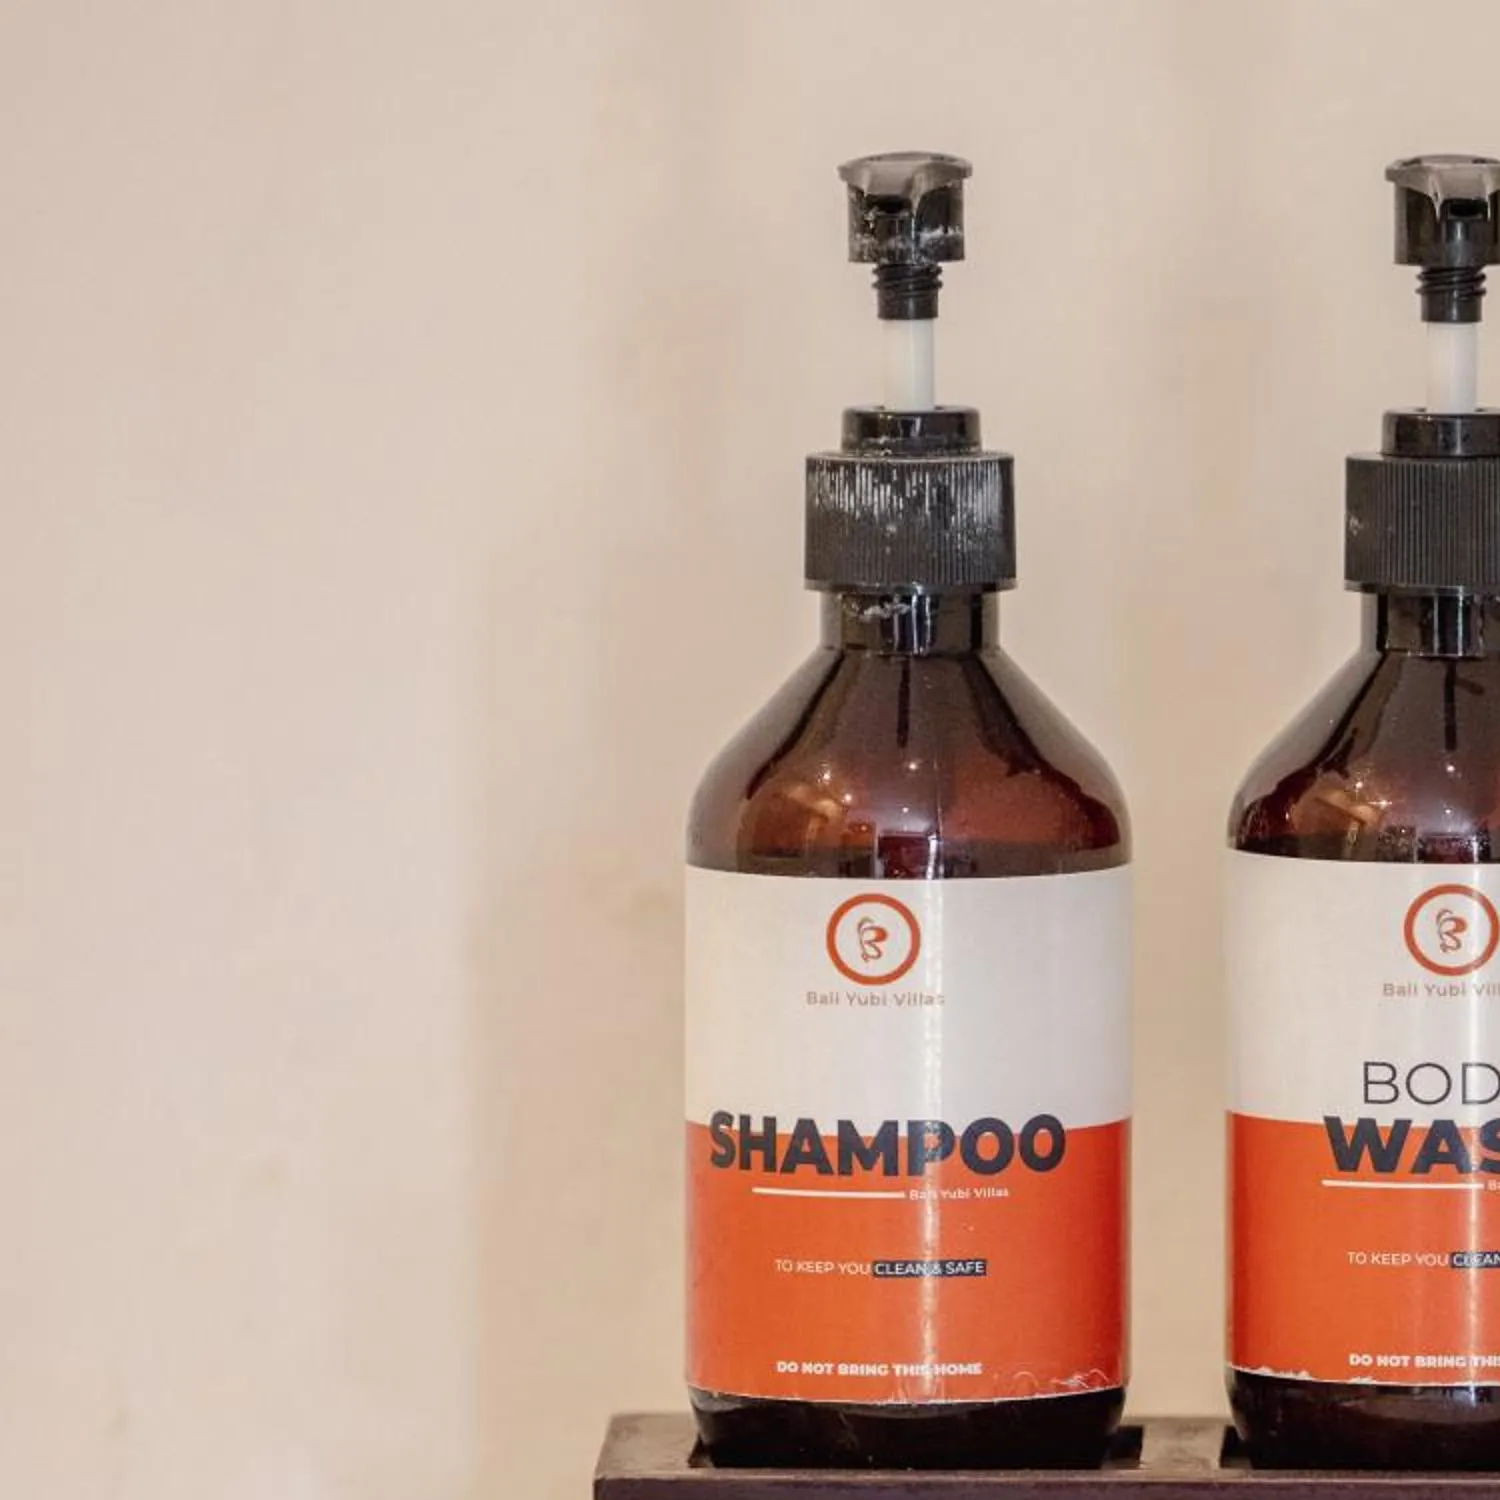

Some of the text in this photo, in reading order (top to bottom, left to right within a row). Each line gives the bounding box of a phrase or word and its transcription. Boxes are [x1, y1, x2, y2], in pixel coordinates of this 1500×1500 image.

[1383, 982, 1417, 997] Bali
[1424, 982, 1467, 998] Yubi
[806, 991, 839, 1006] Bali
[845, 991, 887, 1007] Yubi
[709, 1110, 1066, 1177] SHAMPOO
[974, 1187, 1009, 1199] Villas
[775, 1258, 985, 1276] TO KEEP YOU CLEAN & SAFE
[1348, 1251, 1367, 1265] TO
[1370, 1252, 1411, 1266] KEEP
[1415, 1253, 1449, 1267] YOU
[776, 1361, 983, 1376] DO NOT BRING THIS HOME
[1349, 1353, 1373, 1366] DO
[1376, 1355, 1411, 1367] NOT
[1414, 1355, 1467, 1368] BRING
